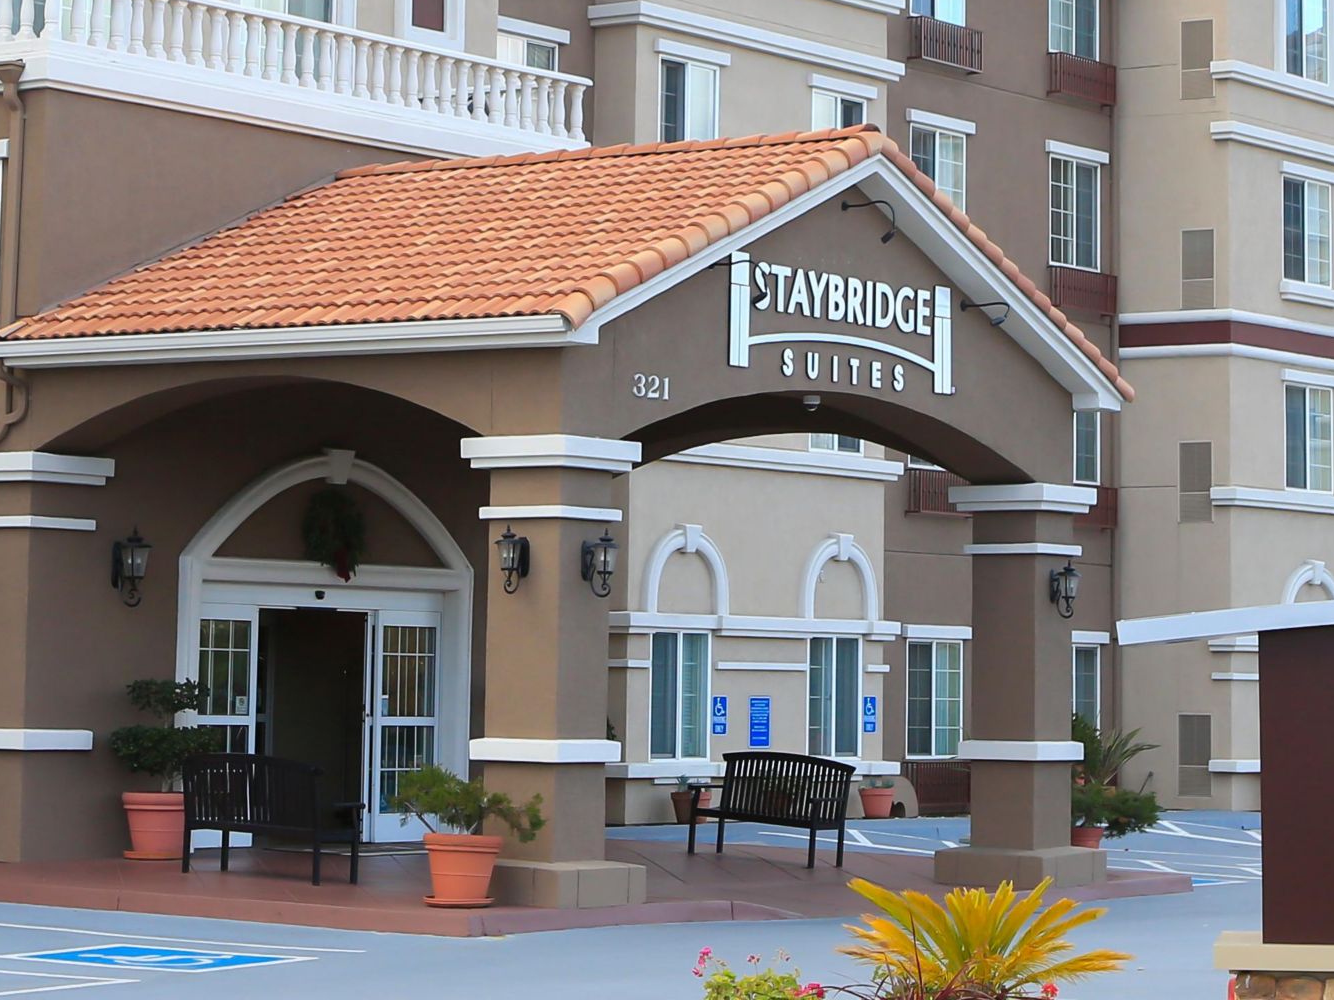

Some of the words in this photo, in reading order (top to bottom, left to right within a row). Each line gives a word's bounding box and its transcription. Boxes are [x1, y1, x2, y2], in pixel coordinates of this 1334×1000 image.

[754, 261, 933, 336] STAYBRIDGE
[632, 373, 670, 400] 321
[781, 348, 905, 392] SUITES
